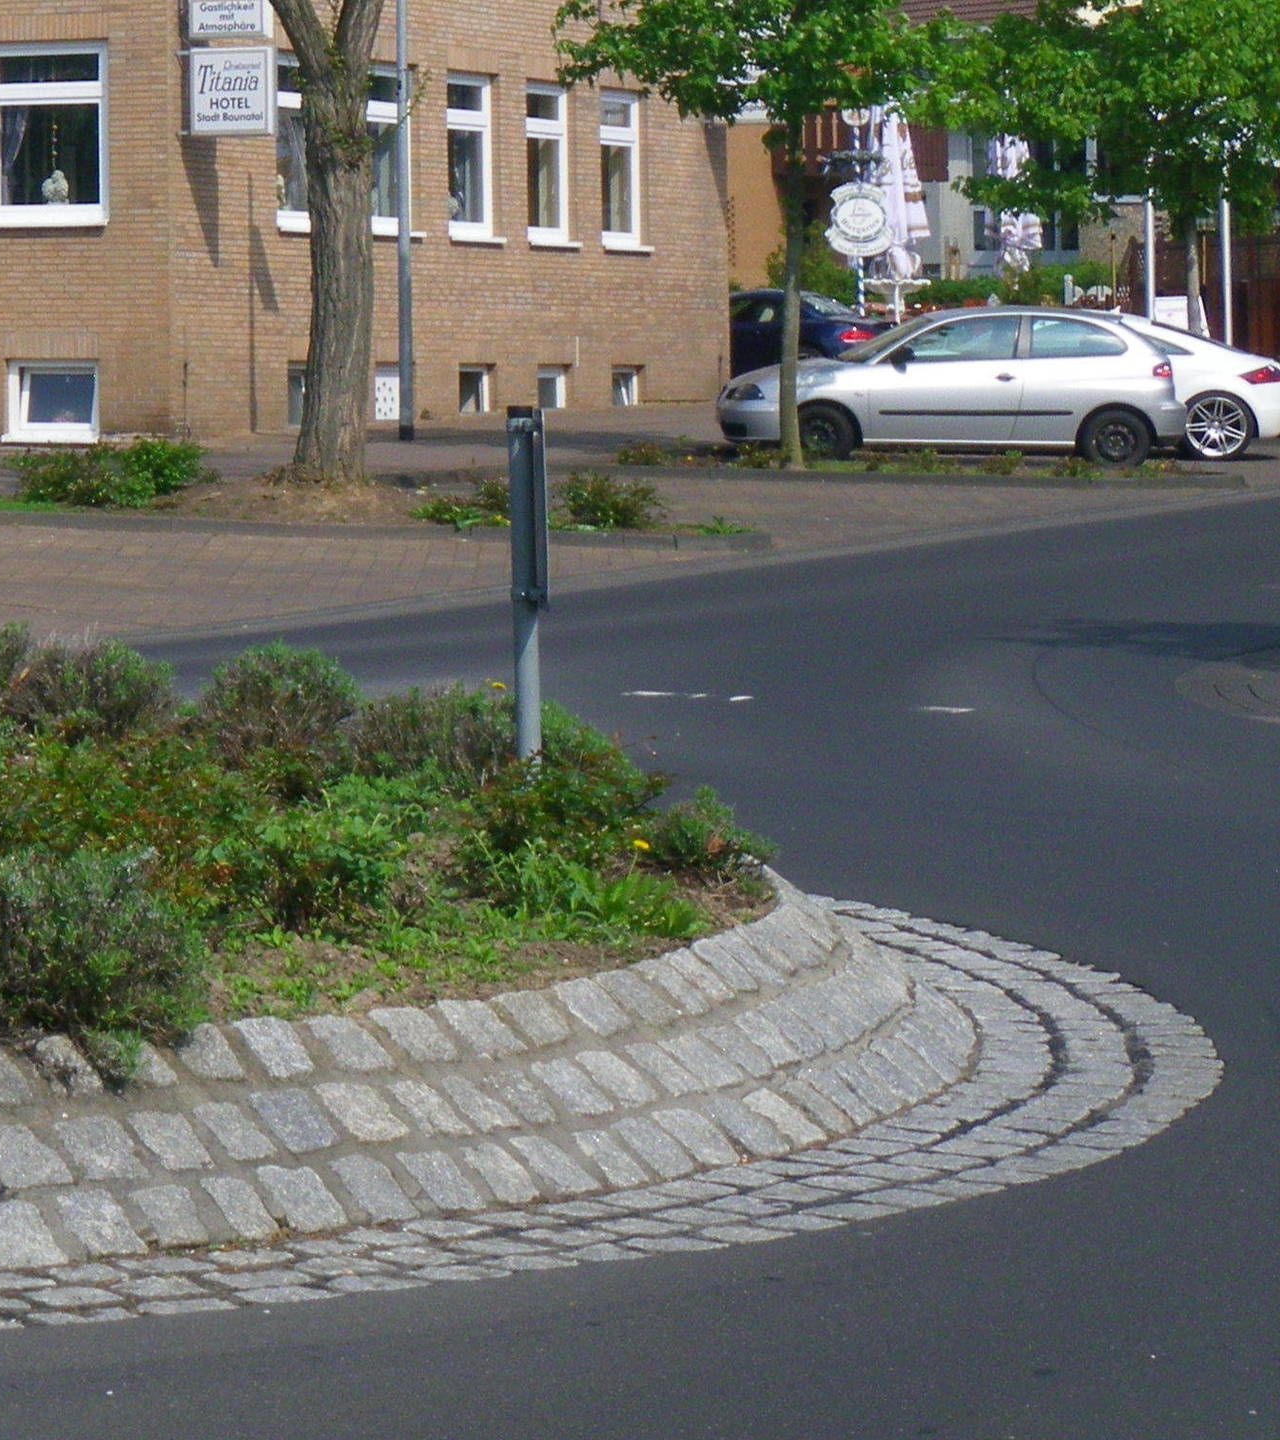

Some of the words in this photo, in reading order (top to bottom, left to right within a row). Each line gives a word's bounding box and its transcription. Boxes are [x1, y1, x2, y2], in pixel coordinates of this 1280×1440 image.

[199, 2, 255, 12] Gastlichkeit
[198, 64, 259, 94] Titania
[209, 97, 251, 109] HOTEL
[197, 112, 220, 122] Stadt
[222, 111, 264, 121] Baunatal
